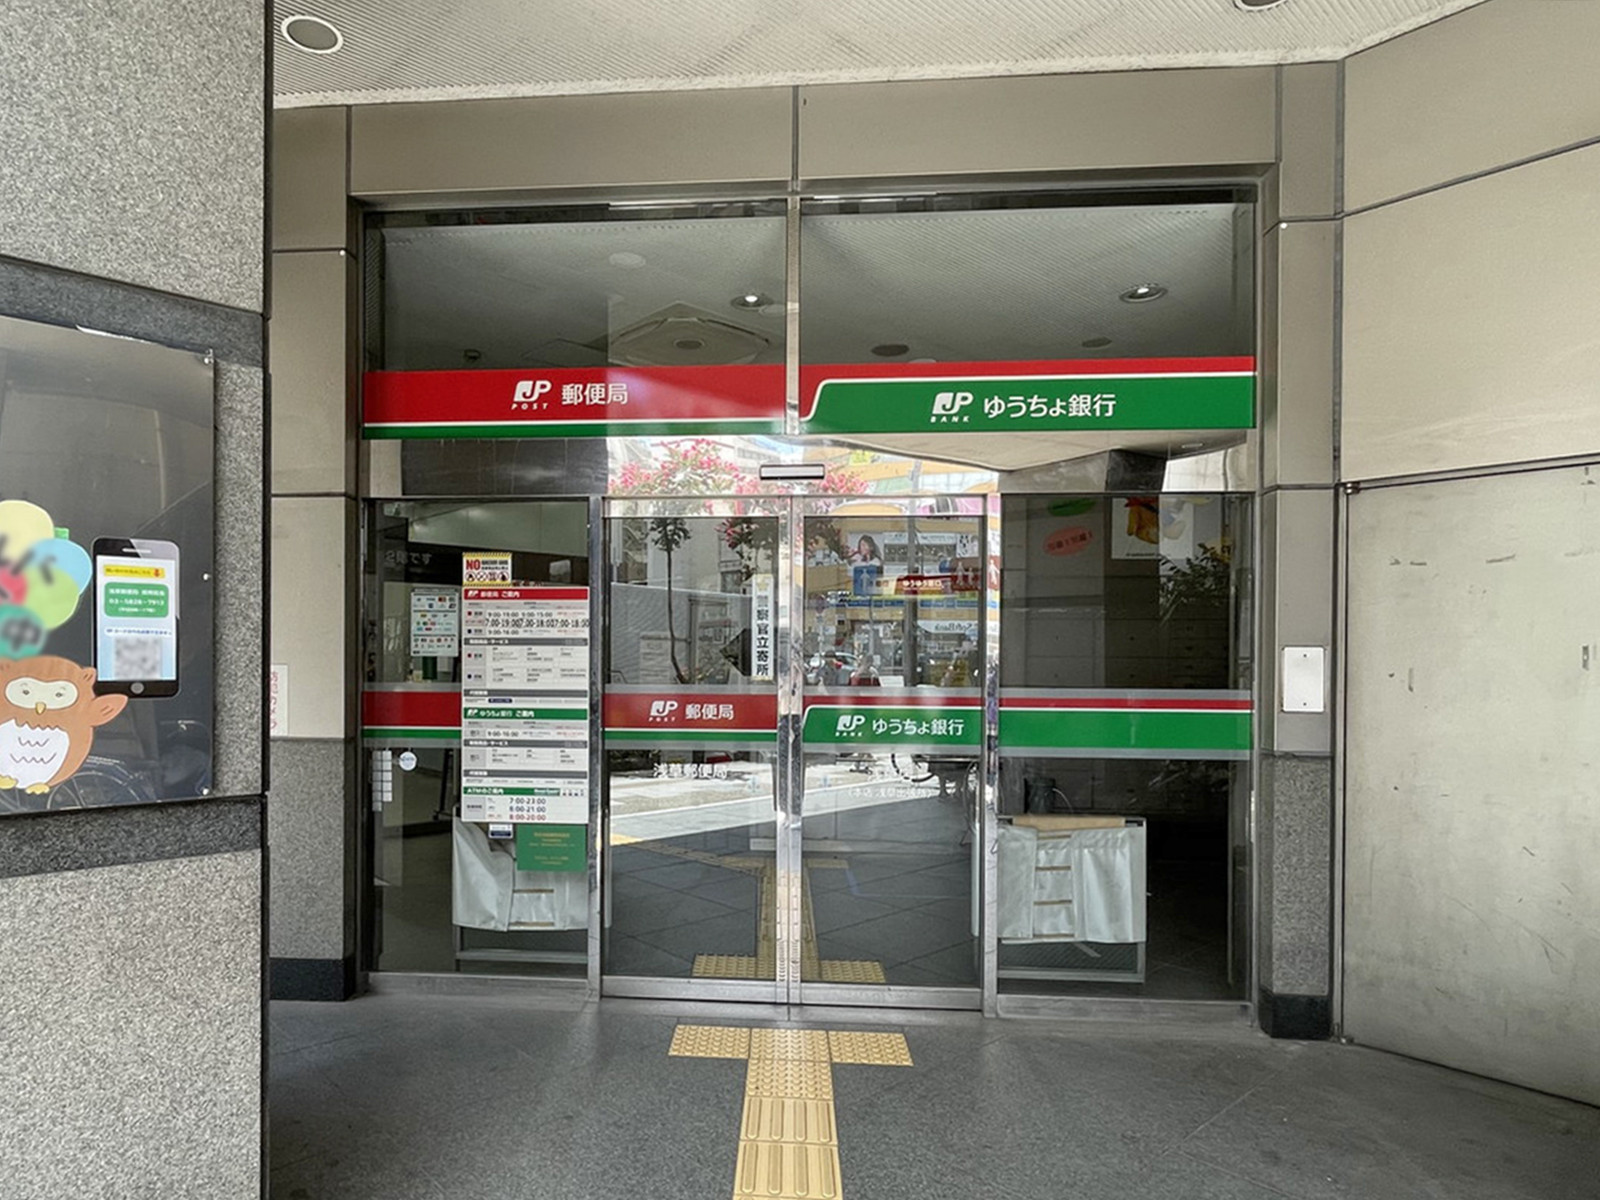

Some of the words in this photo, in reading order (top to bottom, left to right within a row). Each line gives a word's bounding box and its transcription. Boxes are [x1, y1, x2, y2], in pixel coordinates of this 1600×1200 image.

[561, 383, 628, 405] 郵便局
[983, 394, 1116, 419] ゆうちょ銀行
[466, 559, 480, 570] NO
[501, 590, 520, 598] ご案内
[479, 709, 513, 717] ゆうちょ銀行
[515, 709, 535, 718] ご案内
[685, 704, 734, 720] 郵便局
[872, 718, 964, 736] ゆうちょ銀行
[653, 762, 728, 780] 浅草郵便局
